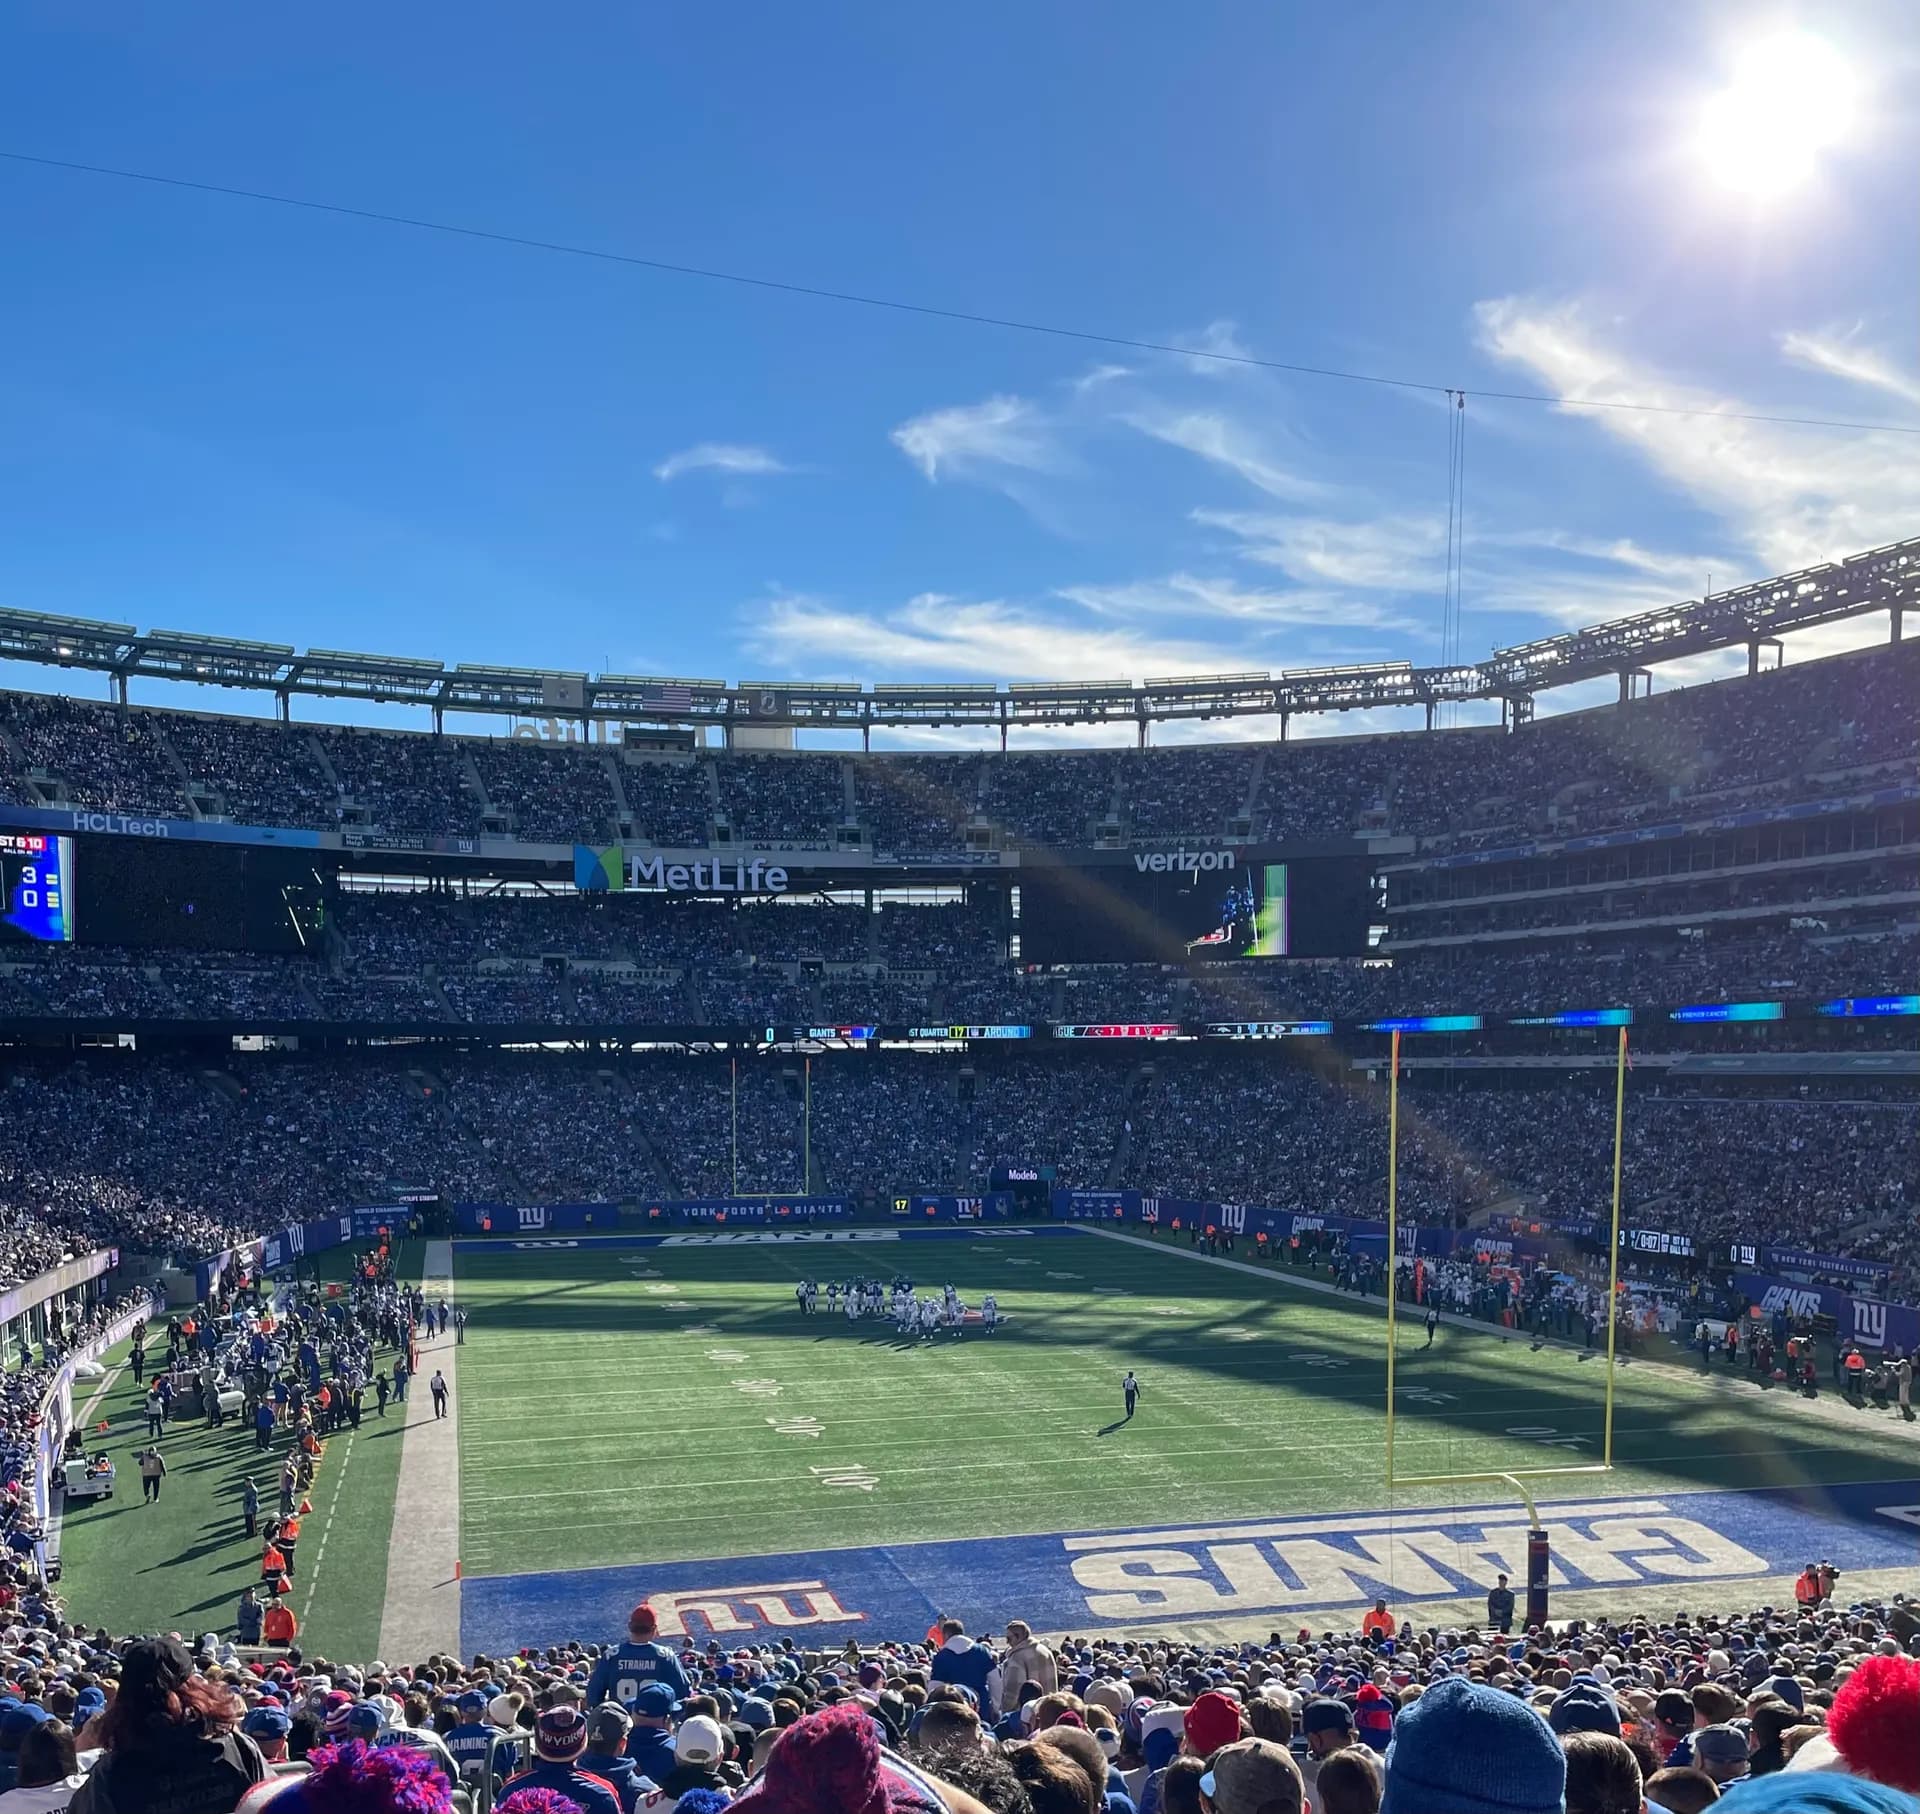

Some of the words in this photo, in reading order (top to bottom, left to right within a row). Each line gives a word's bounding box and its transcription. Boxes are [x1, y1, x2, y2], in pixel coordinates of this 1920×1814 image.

[72, 812, 169, 838] HCLTech
[28, 838, 43, 849] 10
[1134, 846, 1235, 872] verizon
[22, 866, 37, 884] 3
[631, 855, 789, 892] MetLife
[23, 890, 38, 908] 0
[766, 1028, 774, 1042] 0
[809, 1028, 836, 1038] GIANTS
[920, 1028, 948, 1037] QUARTER
[984, 1027, 1020, 1037] AROUND
[1008, 1169, 1038, 1181] Modelo
[683, 1208, 716, 1217] YORK
[723, 1206, 789, 1216] FOOTBL
[795, 1205, 842, 1214] GIANTS
[895, 1200, 907, 1210] 17
[518, 1206, 545, 1230] ny
[1220, 1204, 1246, 1234] ny
[661, 1230, 900, 1245] GIANTS
[1619, 1230, 1625, 1246] 3
[1641, 1233, 1658, 1249] 0:07
[1741, 1245, 1755, 1265] ny
[1761, 1285, 1822, 1317] GIANTS
[1853, 1300, 1887, 1348] ny
[809, 1462, 881, 1487] 10
[1071, 1517, 1770, 1618] GIANTS
[618, 1659, 657, 1671] STRAHAN
[447, 1736, 489, 1752] MANNING
